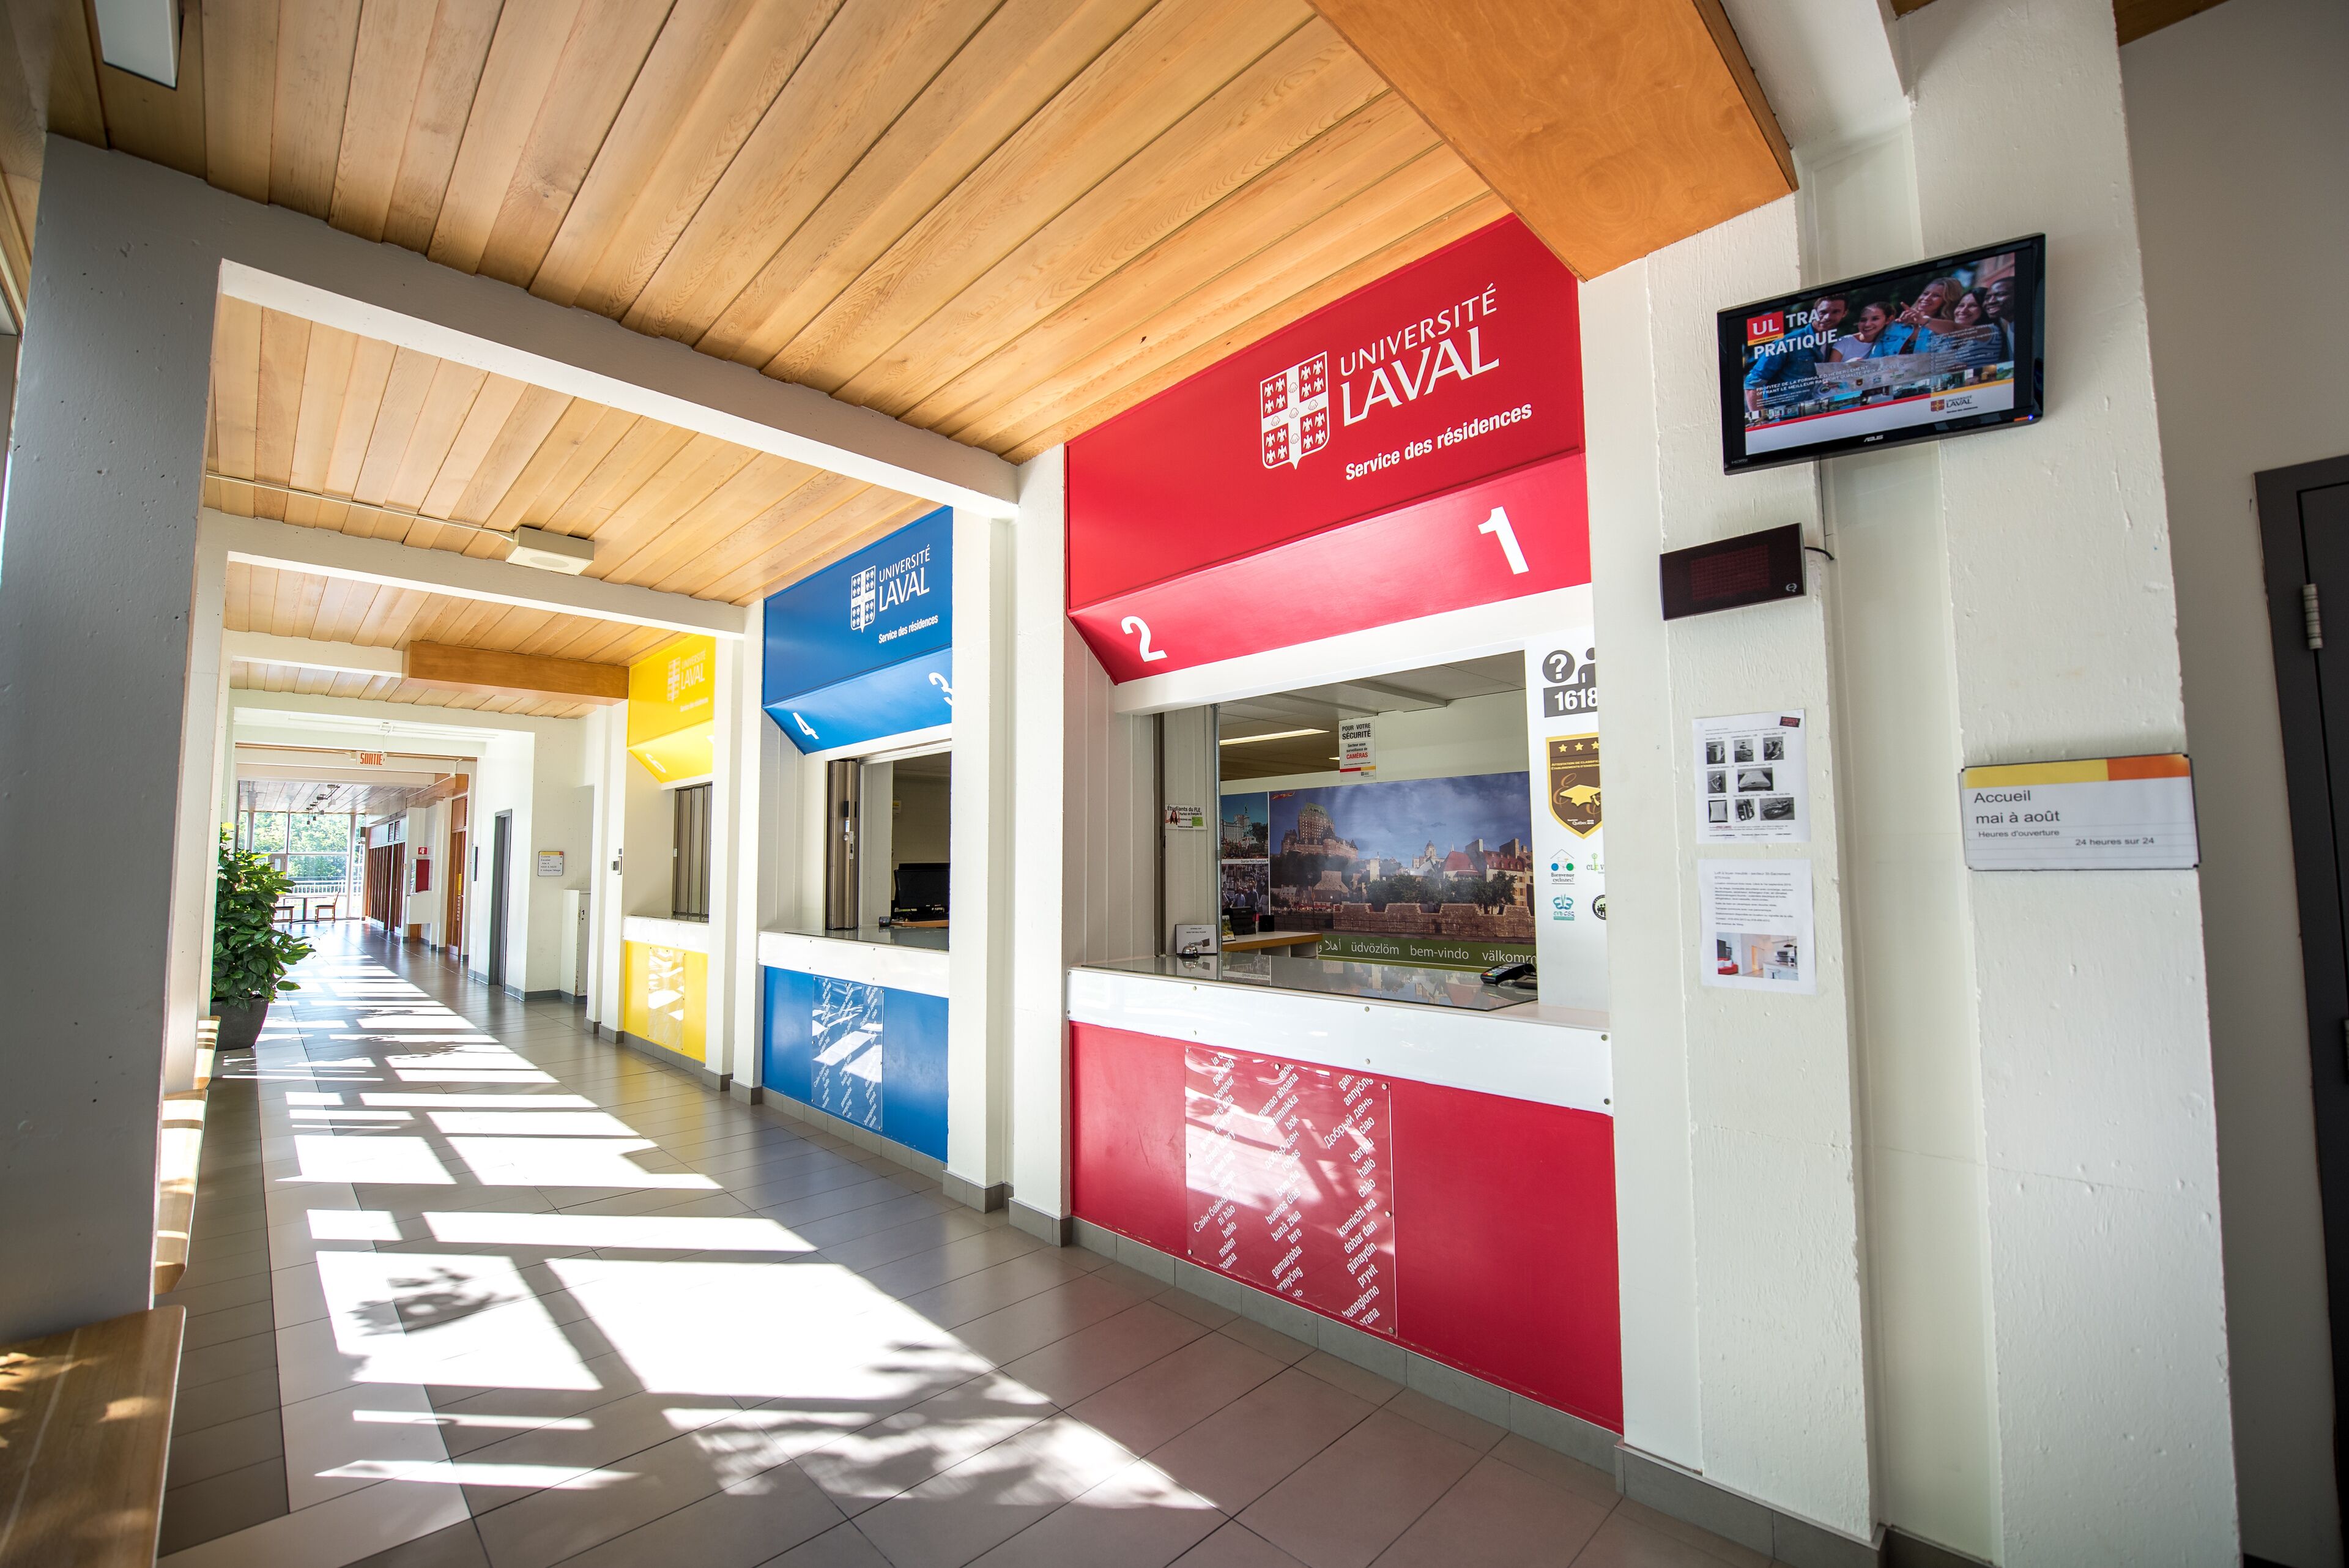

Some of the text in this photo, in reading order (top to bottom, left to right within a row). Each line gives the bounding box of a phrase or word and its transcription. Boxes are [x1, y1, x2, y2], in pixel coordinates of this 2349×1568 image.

[1340, 283, 1497, 376] UNIVERSITÉ
[1753, 309, 1820, 335] UL TRA
[1340, 325, 1500, 426] LAVAL
[1946, 399, 1972, 408] LAVAL
[1346, 403, 1532, 480] Service des résidences
[1478, 506, 1529, 574] 1
[879, 544, 930, 582] UNIVERSITÉ
[878, 567, 930, 612] LAVAL
[878, 614, 938, 644] Service des résidences
[1121, 615, 1168, 663] 2
[681, 663, 705, 690] LAVAL
[929, 672, 952, 707] 3
[1554, 687, 1598, 711] 1618
[793, 712, 819, 740] 4
[1342, 728, 1371, 740] SÉCURITÉ
[360, 752, 383, 765] SORTIE
[645, 753, 666, 773] 6
[1974, 790, 2031, 804] Accueil
[1976, 810, 2060, 824] mai à août
[2011, 829, 2060, 838] d'ouverture
[1351, 942, 1399, 955] üdvözlöm
[1410, 945, 1469, 959] bem-vindo
[1214, 1075, 1234, 1101] bonjour
[1258, 1072, 1299, 1120] manao ahoana
[1285, 1113, 1299, 1131] bok
[1324, 1097, 1373, 1150] Добрый день
[1359, 1117, 1375, 1135] ciao
[1356, 1157, 1376, 1178] halló
[1358, 1178, 1376, 1198] chào
[1265, 1200, 1288, 1225] buenos
[1336, 1198, 1377, 1238] konnichi wa
[1222, 1221, 1236, 1239] hello
[1271, 1210, 1302, 1242] bună ziua
[1288, 1228, 1302, 1244] tere
[1344, 1220, 1378, 1254] dobar dan
[1219, 1238, 1236, 1258] moien
[1272, 1245, 1303, 1280] gamarjoba
[1357, 1263, 1378, 1288] pryvit
